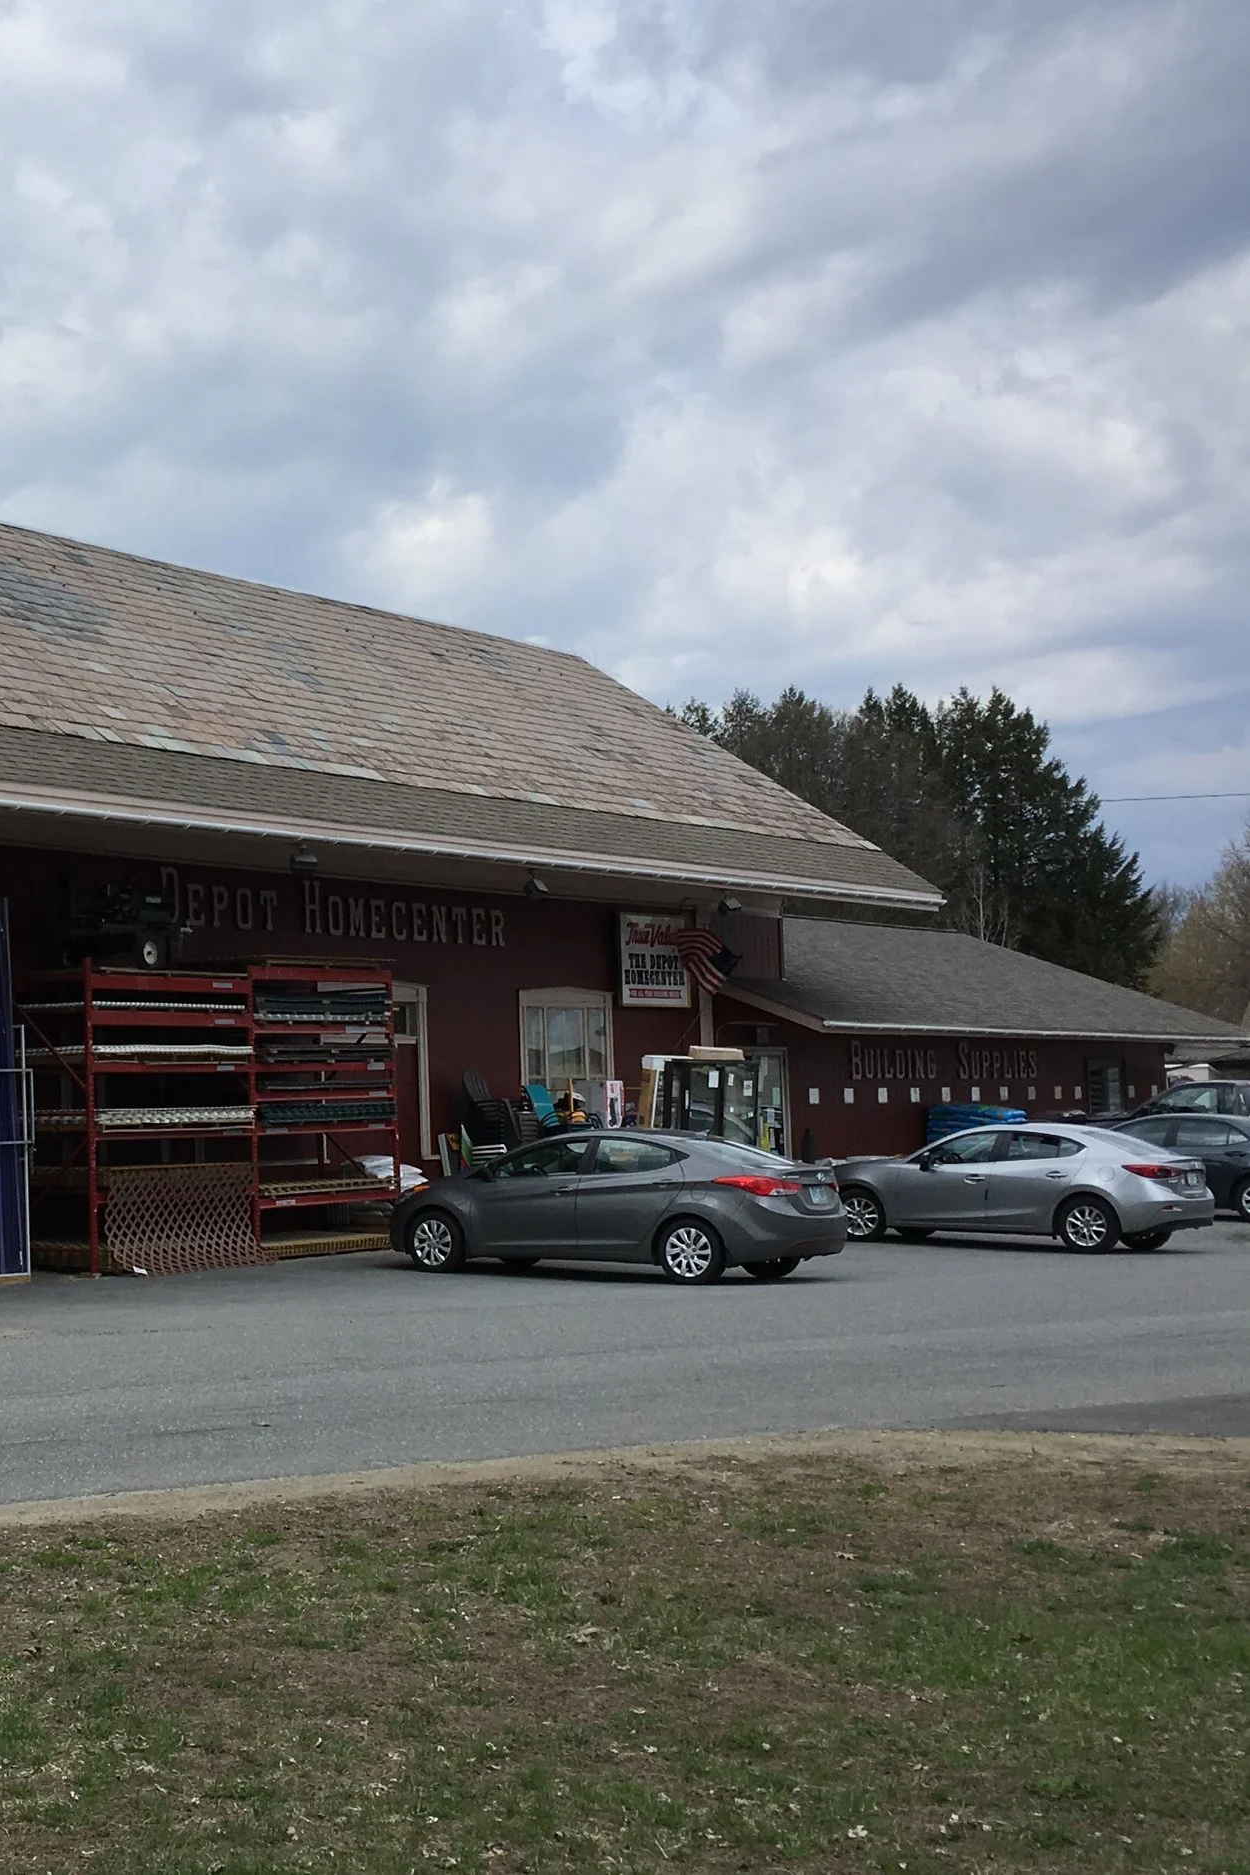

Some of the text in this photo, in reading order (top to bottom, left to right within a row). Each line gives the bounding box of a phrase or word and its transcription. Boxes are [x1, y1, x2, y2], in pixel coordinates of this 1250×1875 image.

[160, 865, 506, 947] DEPOT HOMECENTER
[625, 922, 677, 948] True Valu
[628, 953, 678, 970] THE DEPOT
[624, 969, 685, 986] HOMECENTER
[851, 1041, 1038, 1080] BUILDING SUPPLIES
